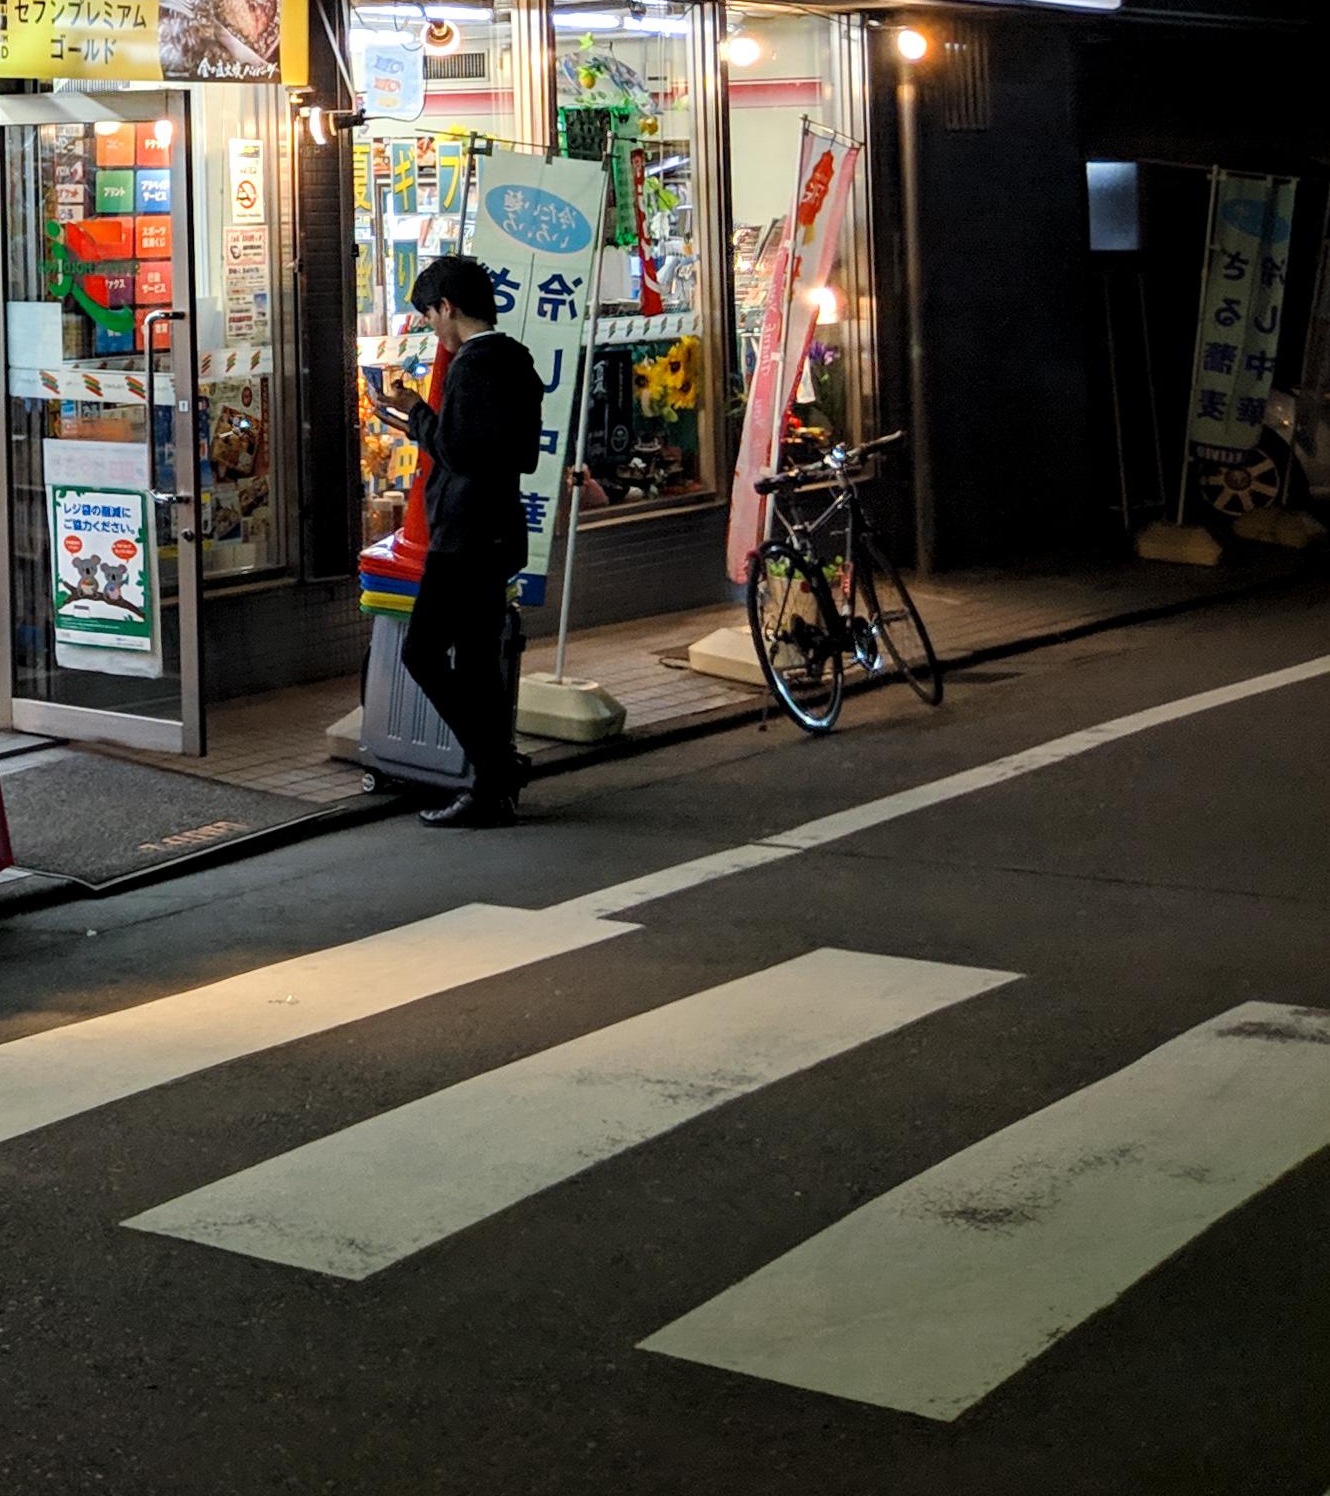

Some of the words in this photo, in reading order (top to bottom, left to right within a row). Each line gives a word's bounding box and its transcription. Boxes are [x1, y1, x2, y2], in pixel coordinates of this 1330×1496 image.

[50, 36, 118, 65] ゴールド
[63, 503, 132, 519] レジ袋の削減に
[63, 519, 136, 535] ご協力ください。
